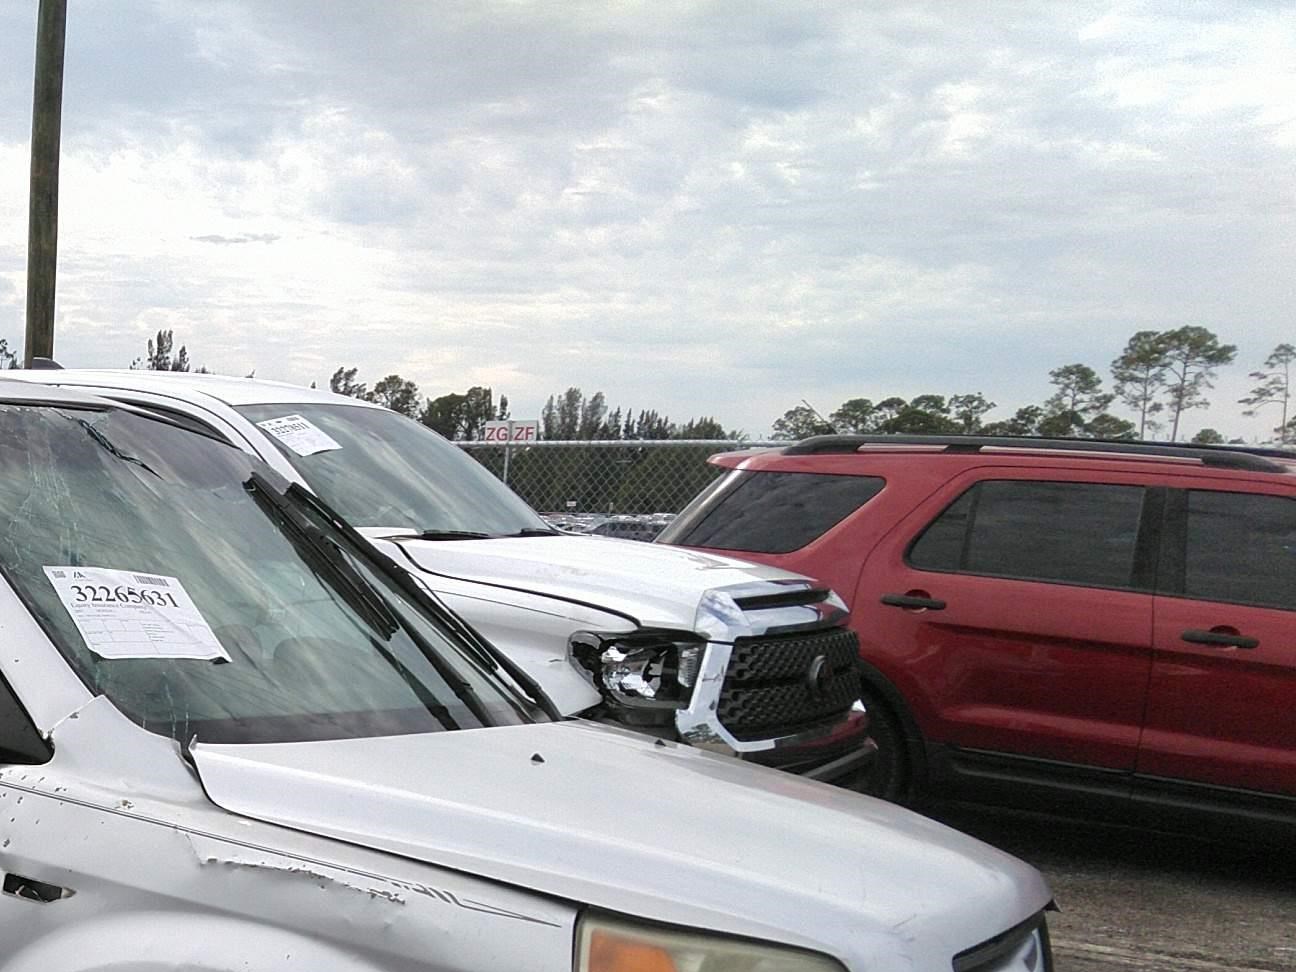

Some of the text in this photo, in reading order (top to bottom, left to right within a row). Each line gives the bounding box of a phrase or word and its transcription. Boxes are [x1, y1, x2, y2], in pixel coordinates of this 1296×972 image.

[486, 427, 509, 441] ZG
[514, 426, 535, 441] ZF
[70, 585, 180, 608] 32265631
